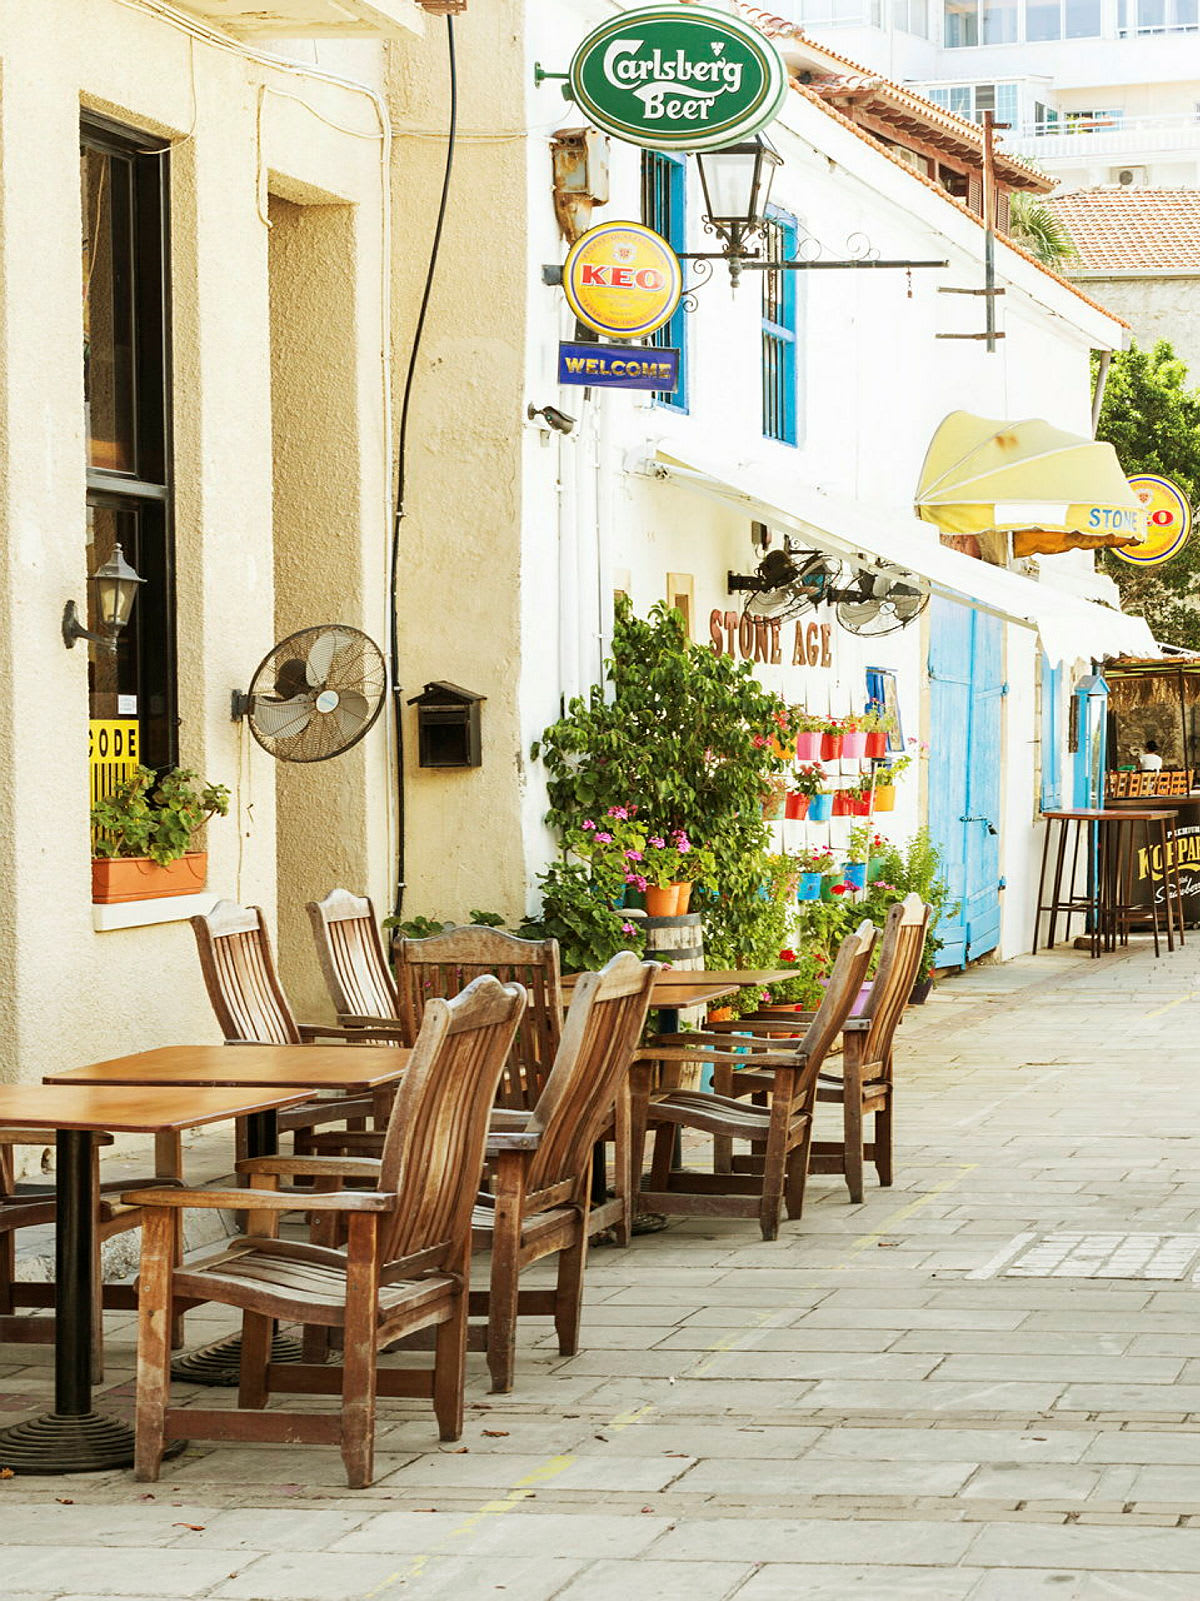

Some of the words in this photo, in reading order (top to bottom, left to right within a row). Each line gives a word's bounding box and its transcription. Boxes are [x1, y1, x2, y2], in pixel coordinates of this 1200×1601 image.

[603, 39, 744, 95] Carlsberg
[632, 92, 716, 120] Beer
[581, 264, 664, 291] KEO
[564, 357, 672, 379] WELCOME
[1088, 507, 1138, 532] STONE
[709, 608, 782, 665] STONE
[792, 620, 833, 668] AGE
